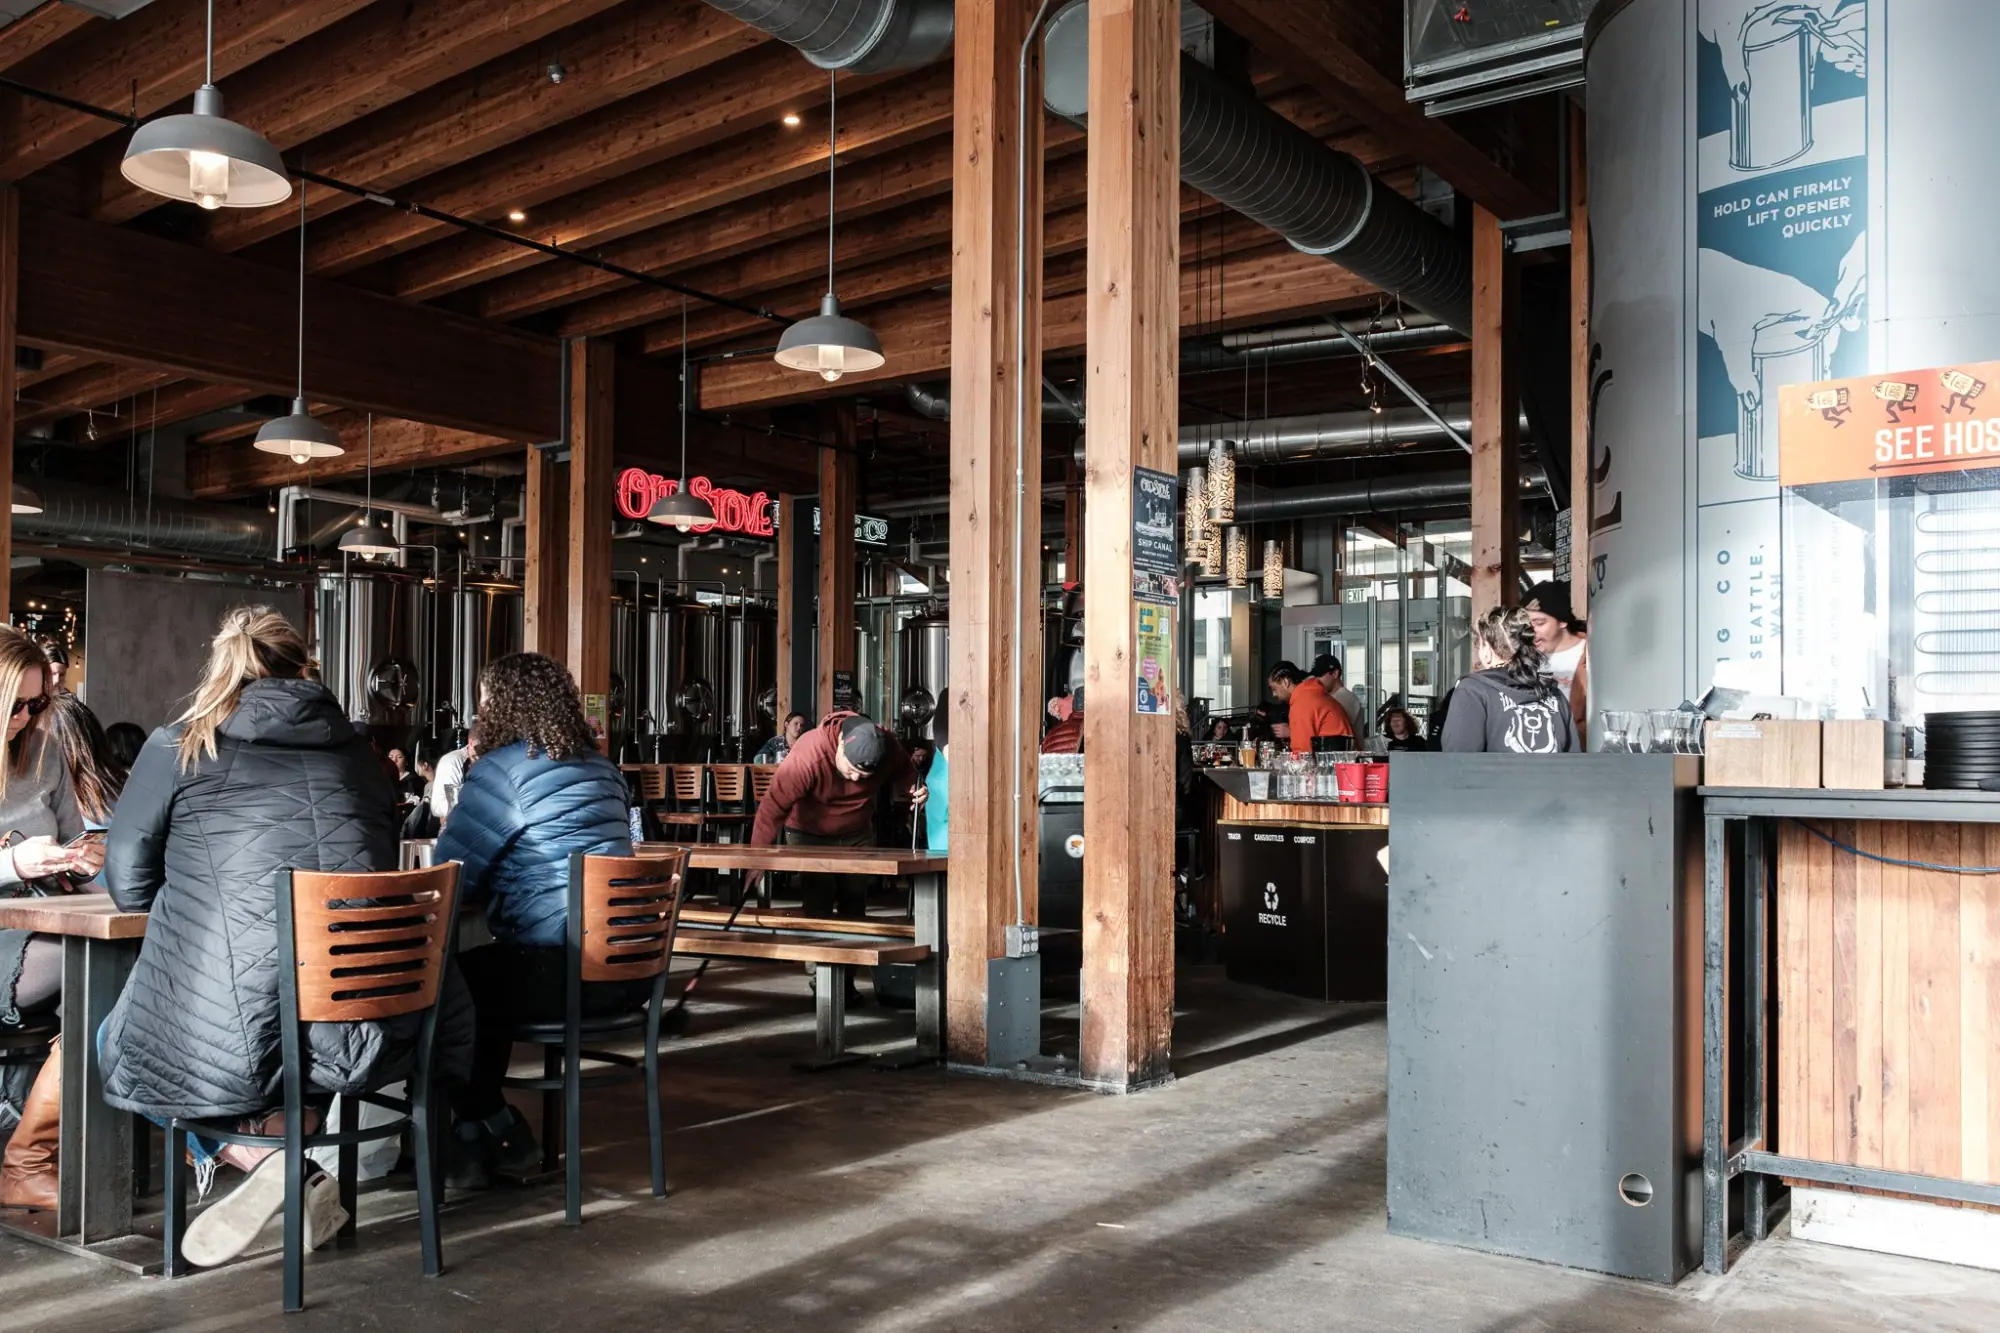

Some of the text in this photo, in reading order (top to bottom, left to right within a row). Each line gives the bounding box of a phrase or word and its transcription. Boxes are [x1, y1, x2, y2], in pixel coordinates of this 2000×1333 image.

[1714, 176, 1852, 218] HOLD CAN FIRMLY
[1747, 195, 1850, 228] LIFT OPENER
[1782, 213, 1853, 239] QUICKLY
[1875, 425, 1934, 462] SEE
[1138, 538, 1172, 553] SHIP CANAL
[1347, 589, 1364, 603] EXIT
[1750, 544, 1764, 660] SEATTLE,
[1770, 574, 1782, 638] WASH
[1294, 836, 1316, 844] COMPOST
[1258, 912, 1287, 926] RECYCLE
